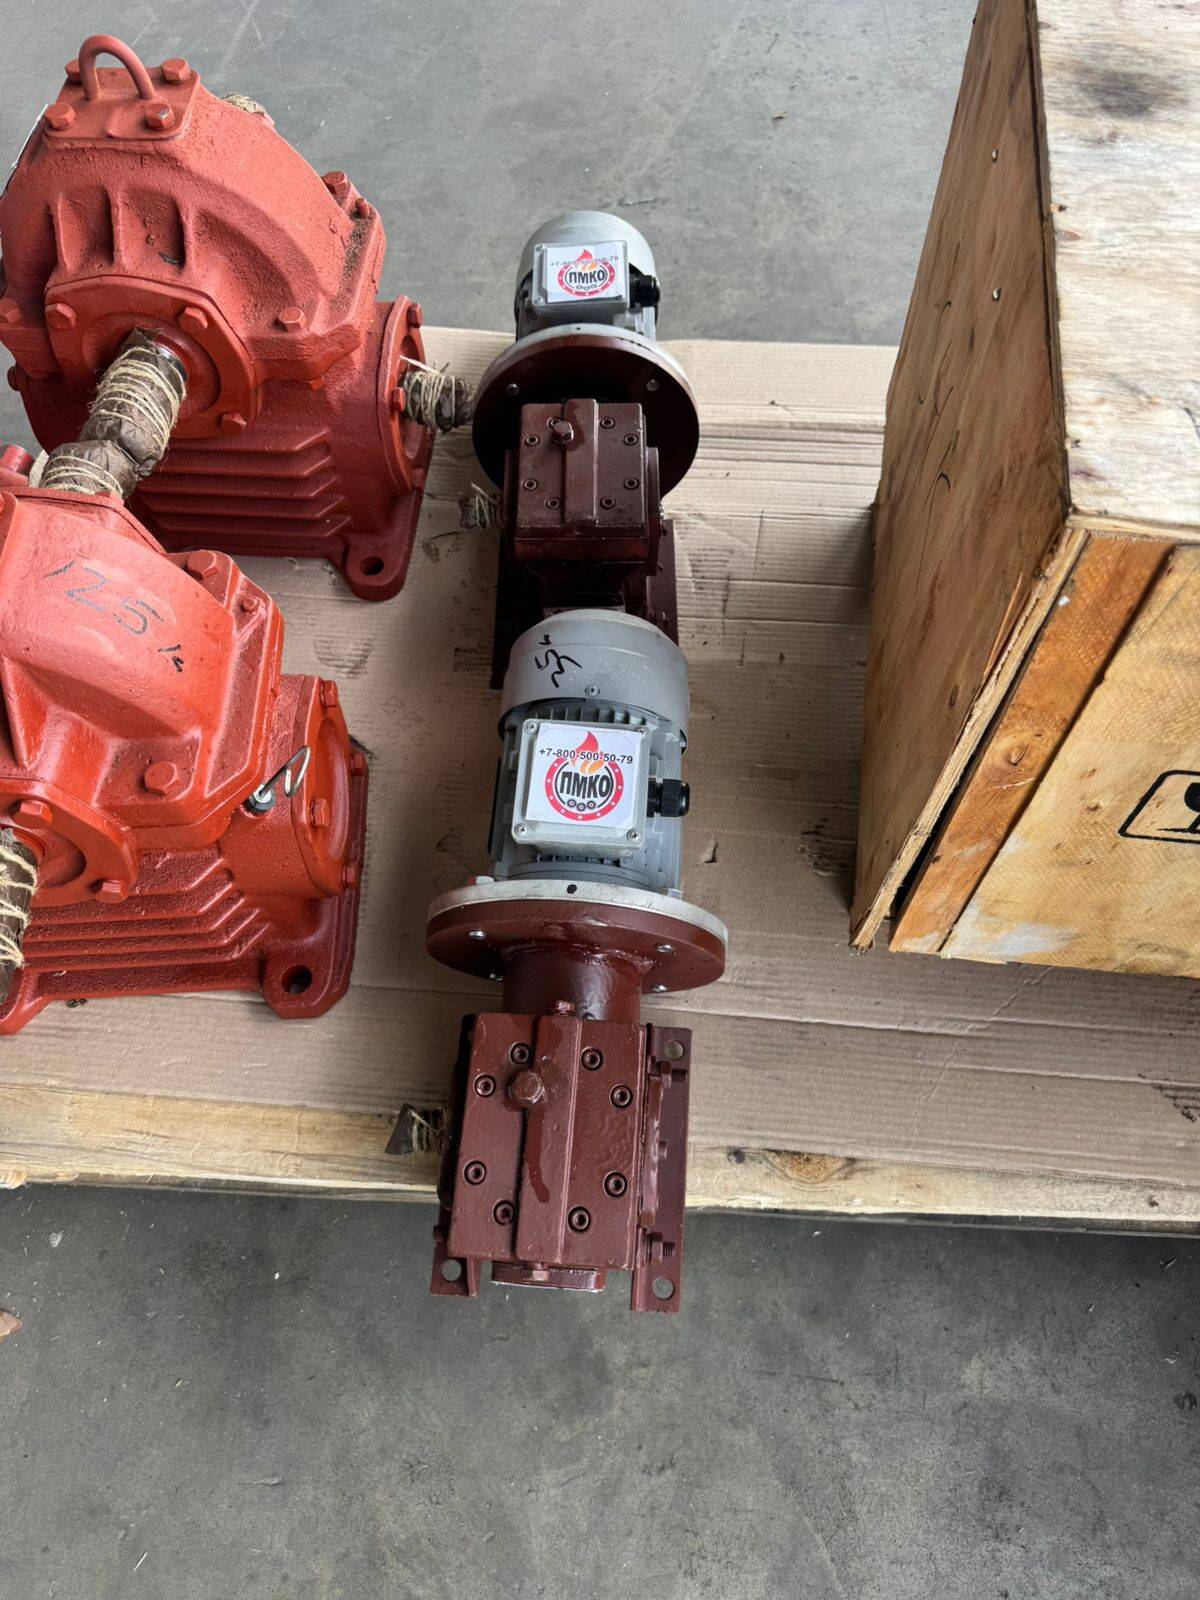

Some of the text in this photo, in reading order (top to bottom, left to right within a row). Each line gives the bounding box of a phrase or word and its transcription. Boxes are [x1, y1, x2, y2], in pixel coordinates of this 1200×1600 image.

[568, 270, 607, 284] ПМКО
[539, 747, 634, 765] +7-800-500-50-79
[559, 771, 612, 799] ПМКО
